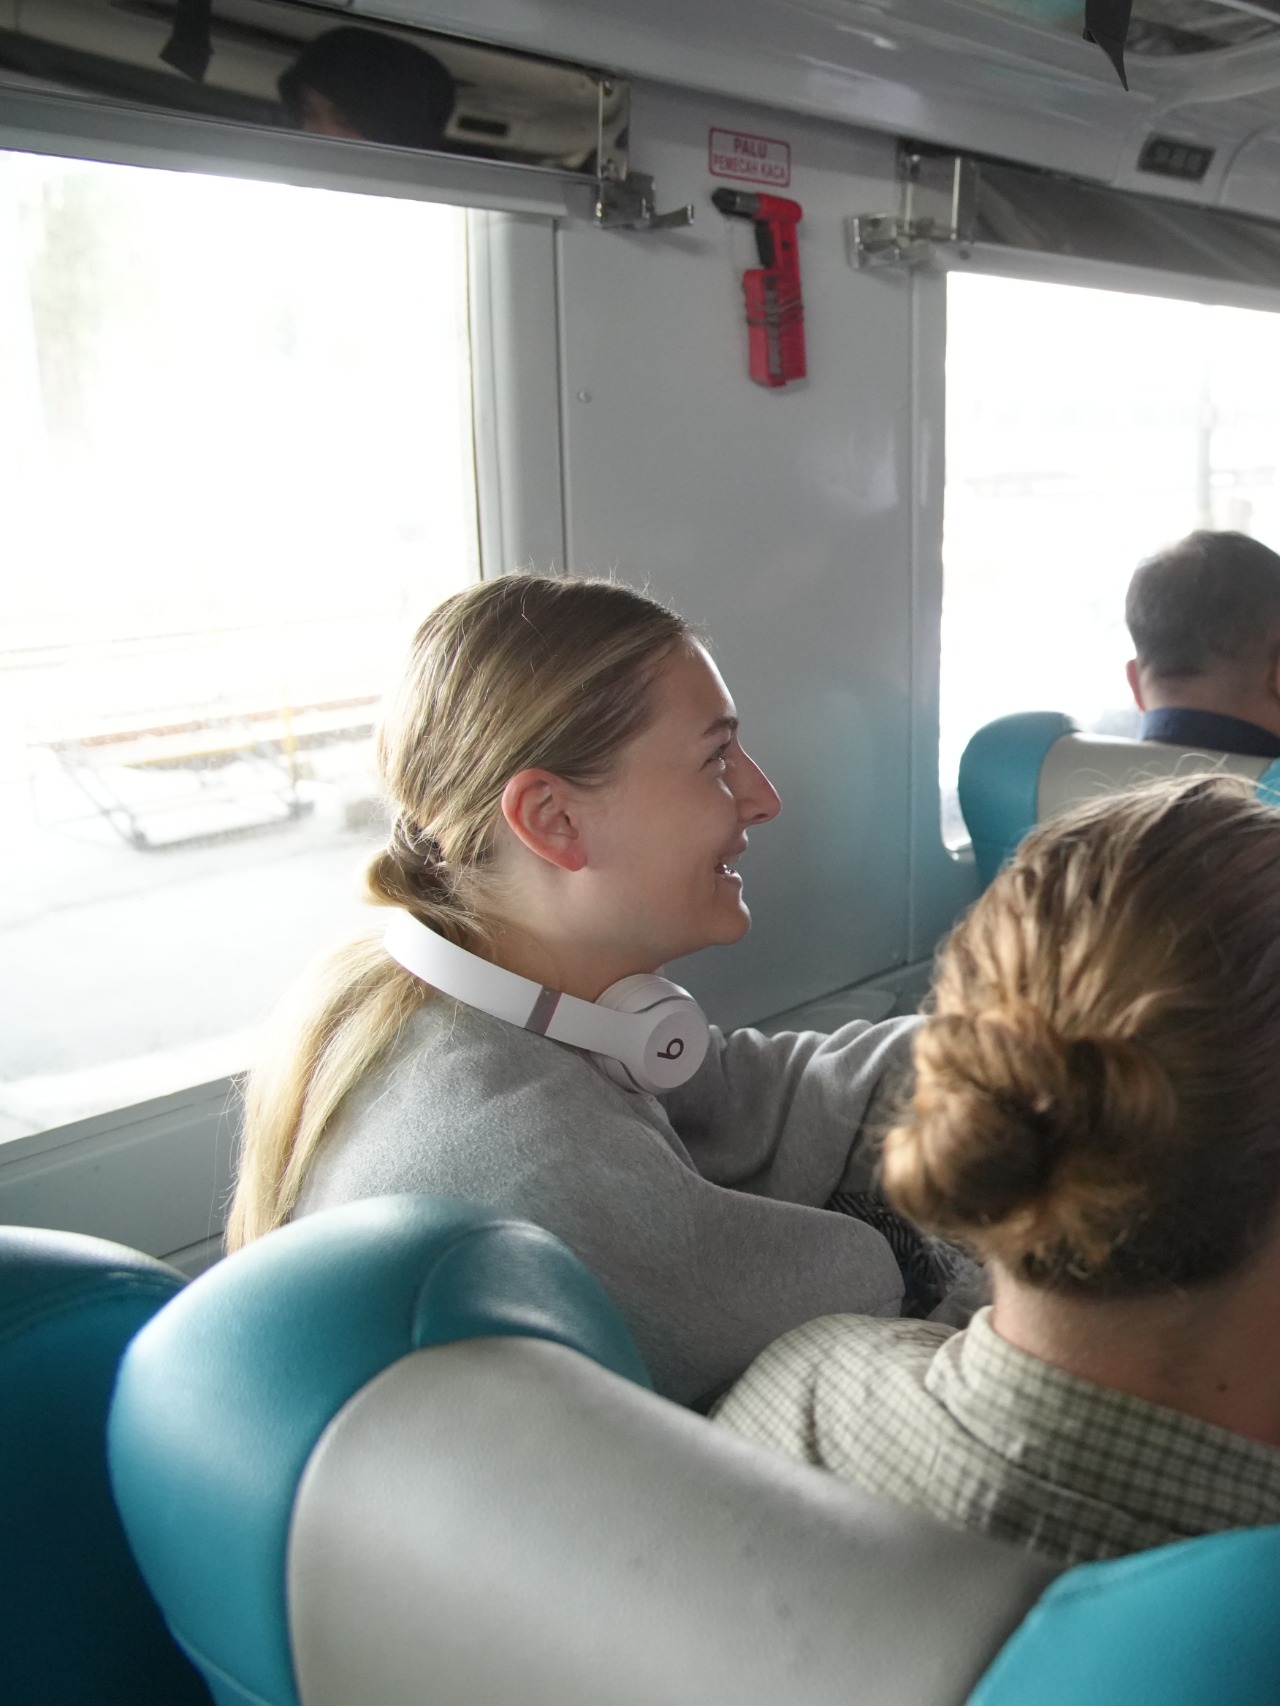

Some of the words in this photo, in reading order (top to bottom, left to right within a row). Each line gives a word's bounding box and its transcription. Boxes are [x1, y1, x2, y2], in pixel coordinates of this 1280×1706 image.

[733, 137, 768, 159] PALU
[713, 153, 759, 175] PEMECAH
[761, 163, 786, 179] KACA
